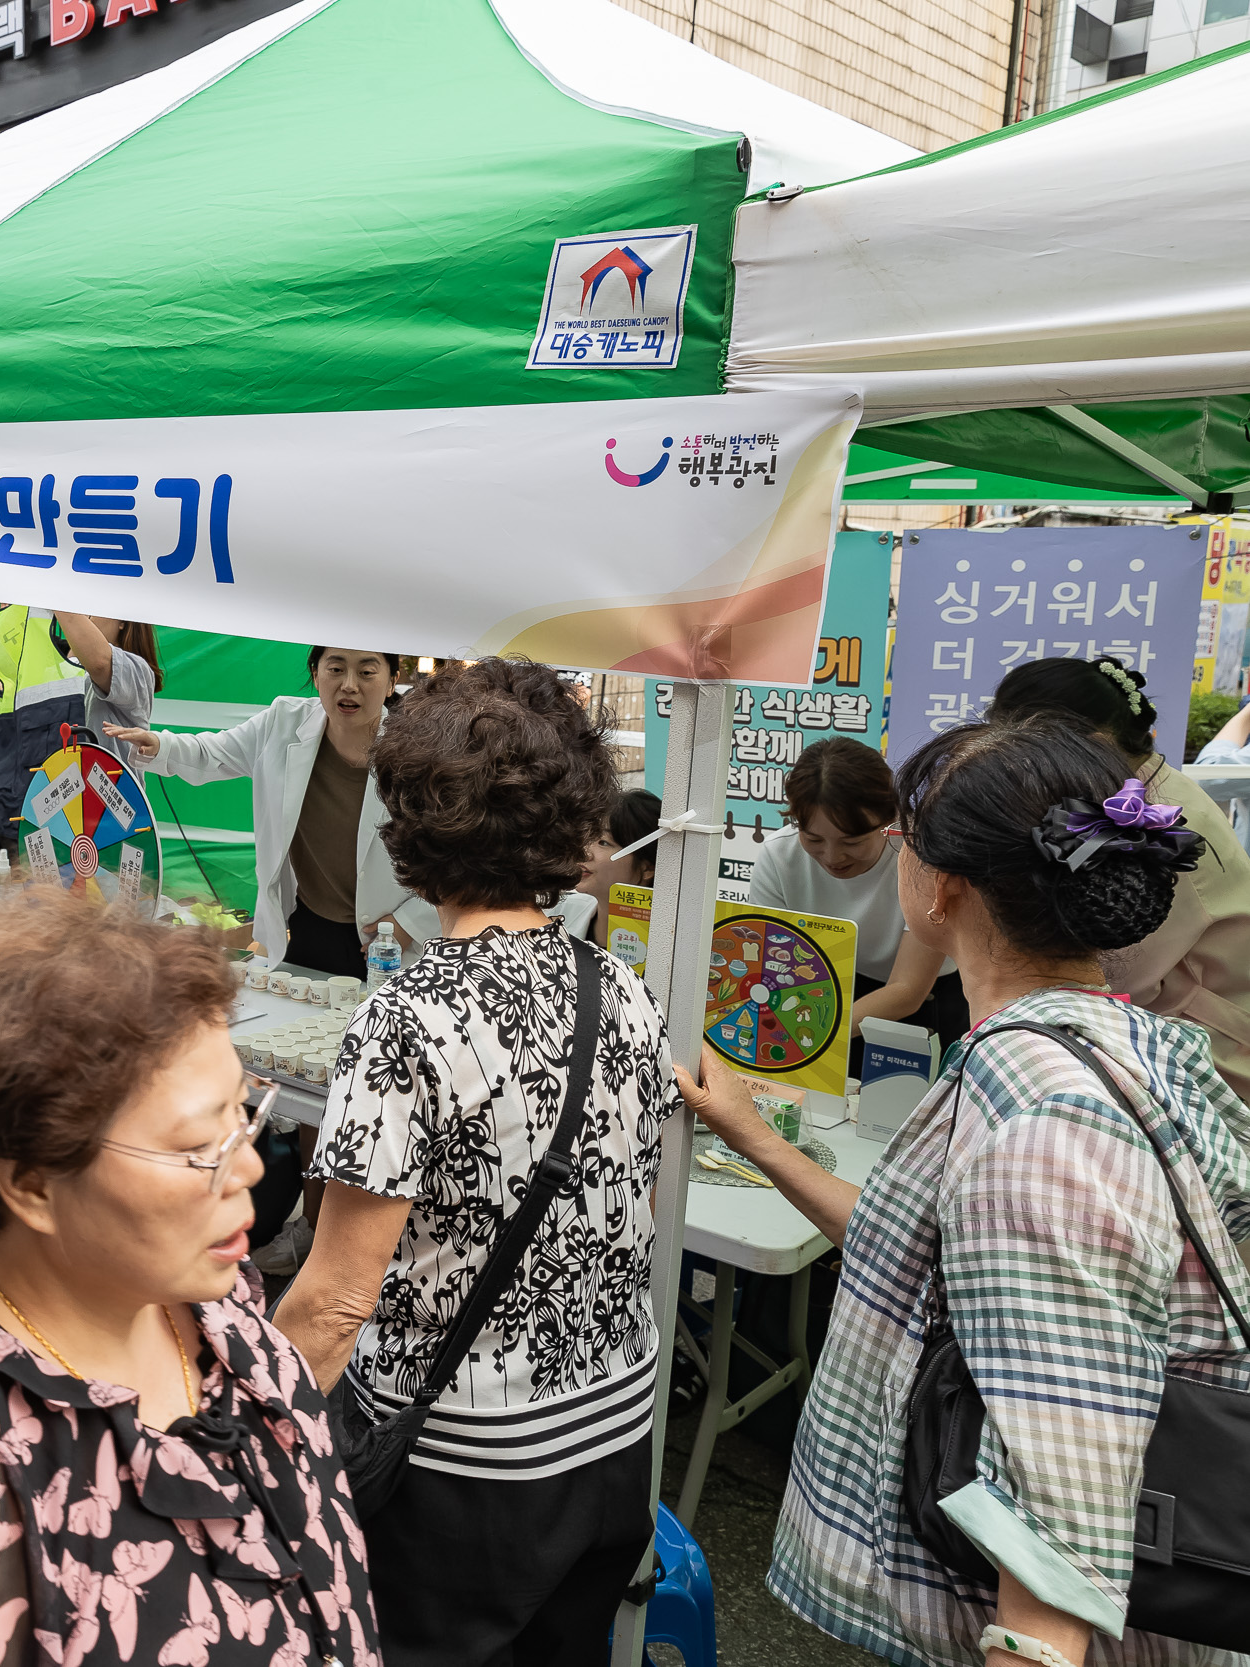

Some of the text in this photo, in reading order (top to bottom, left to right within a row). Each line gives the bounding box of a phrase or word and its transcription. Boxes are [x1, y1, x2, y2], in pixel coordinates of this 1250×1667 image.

[554, 316, 670, 329] THE WORLD BEST DAESEUNG CANOPY
[549, 329, 666, 360] 대승캐노피
[680, 432, 780, 456] 소통하며 발전하는
[677, 455, 777, 490] 행복광진
[934, 580, 1158, 627] 싱거워서
[932, 637, 975, 680] 더
[760, 689, 872, 732] 식생활
[44, 796, 51, 804] Q.
[92, 765, 135, 820] Q. 하루 나트륨 섭취
[806, 920, 847, 934] 광진구보건소
